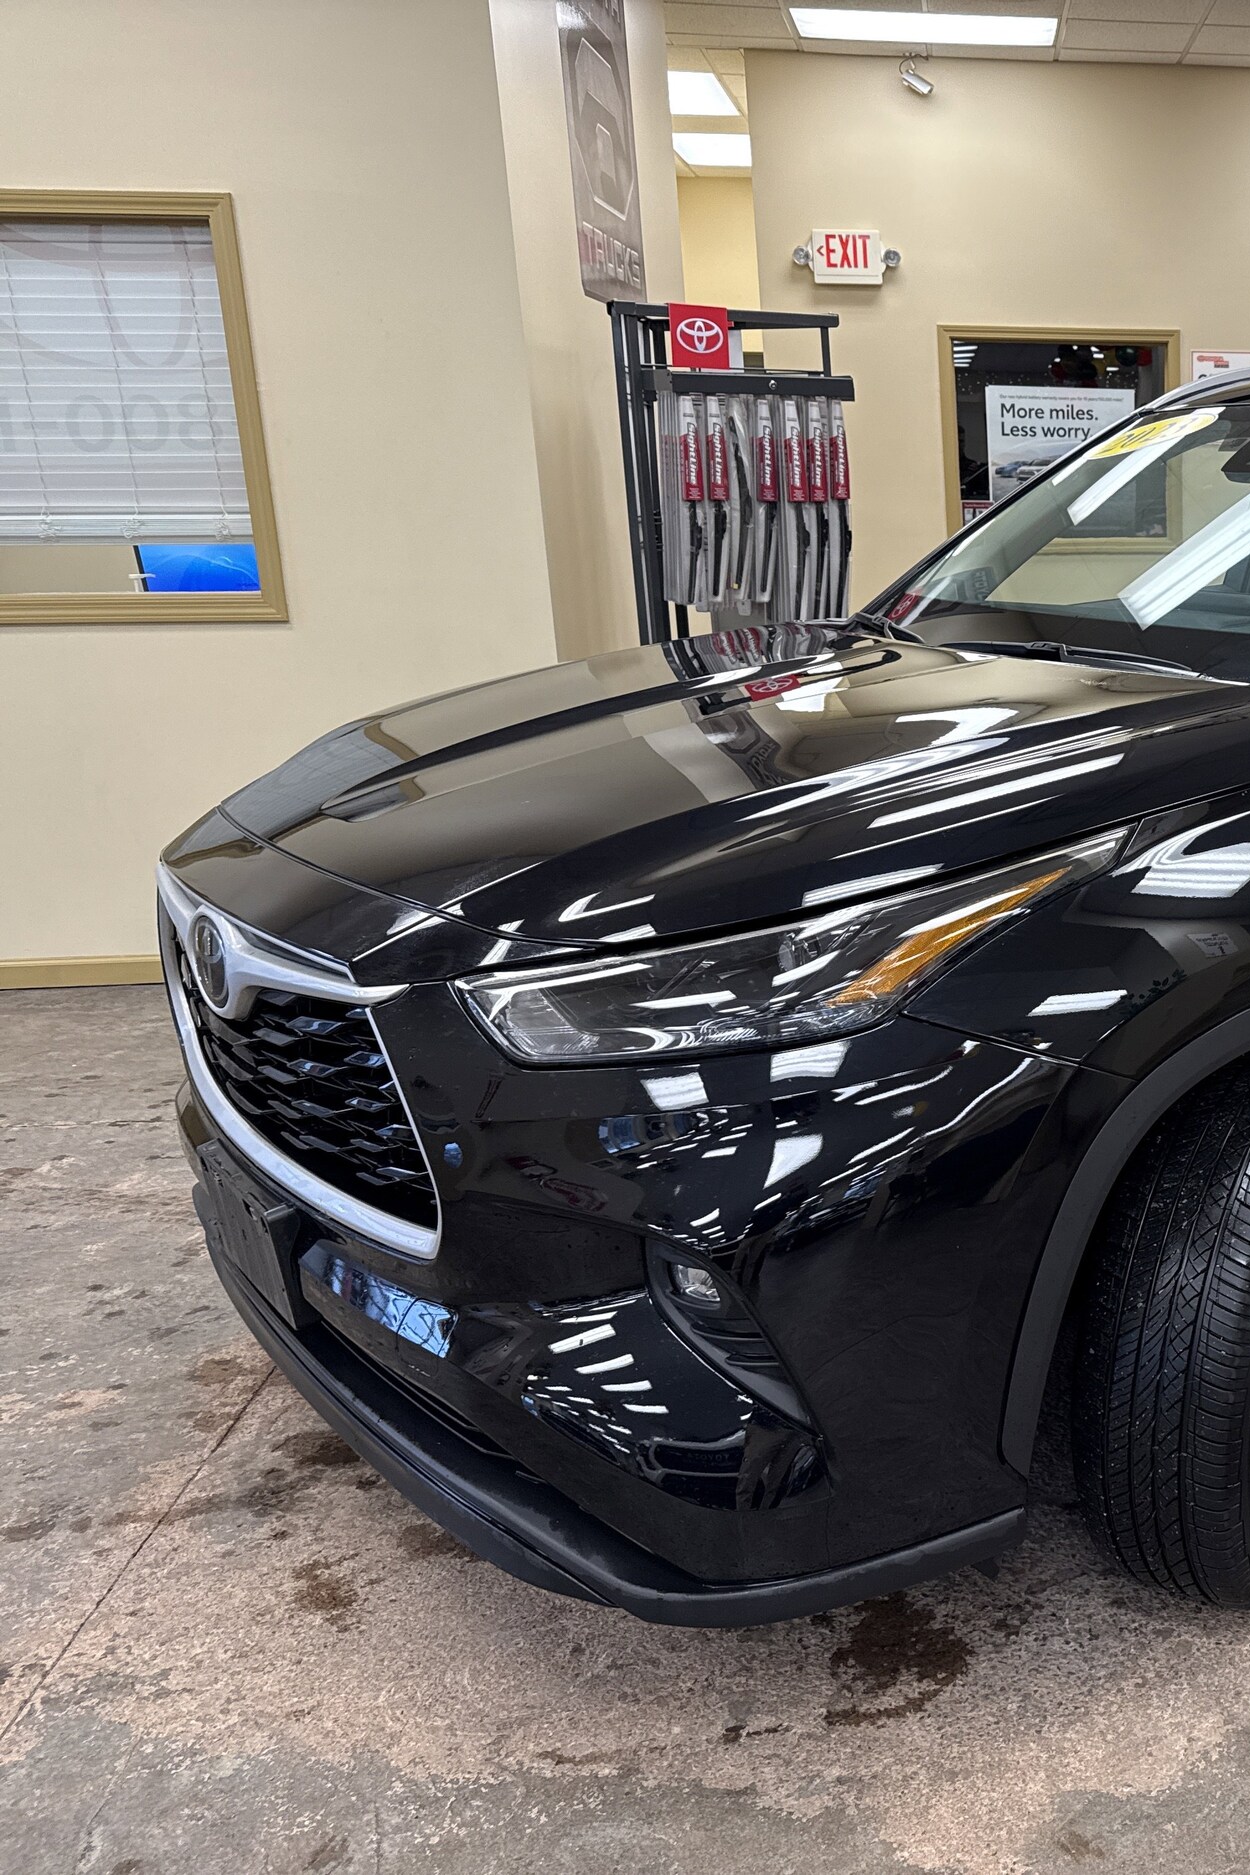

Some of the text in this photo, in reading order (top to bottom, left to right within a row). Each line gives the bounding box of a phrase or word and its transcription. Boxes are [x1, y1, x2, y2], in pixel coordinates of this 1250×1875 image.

[582, 221, 641, 290] TRUCKS
[825, 234, 870, 268] EXIT
[1000, 403, 1099, 421] More miles.
[1001, 421, 1037, 438] Less
